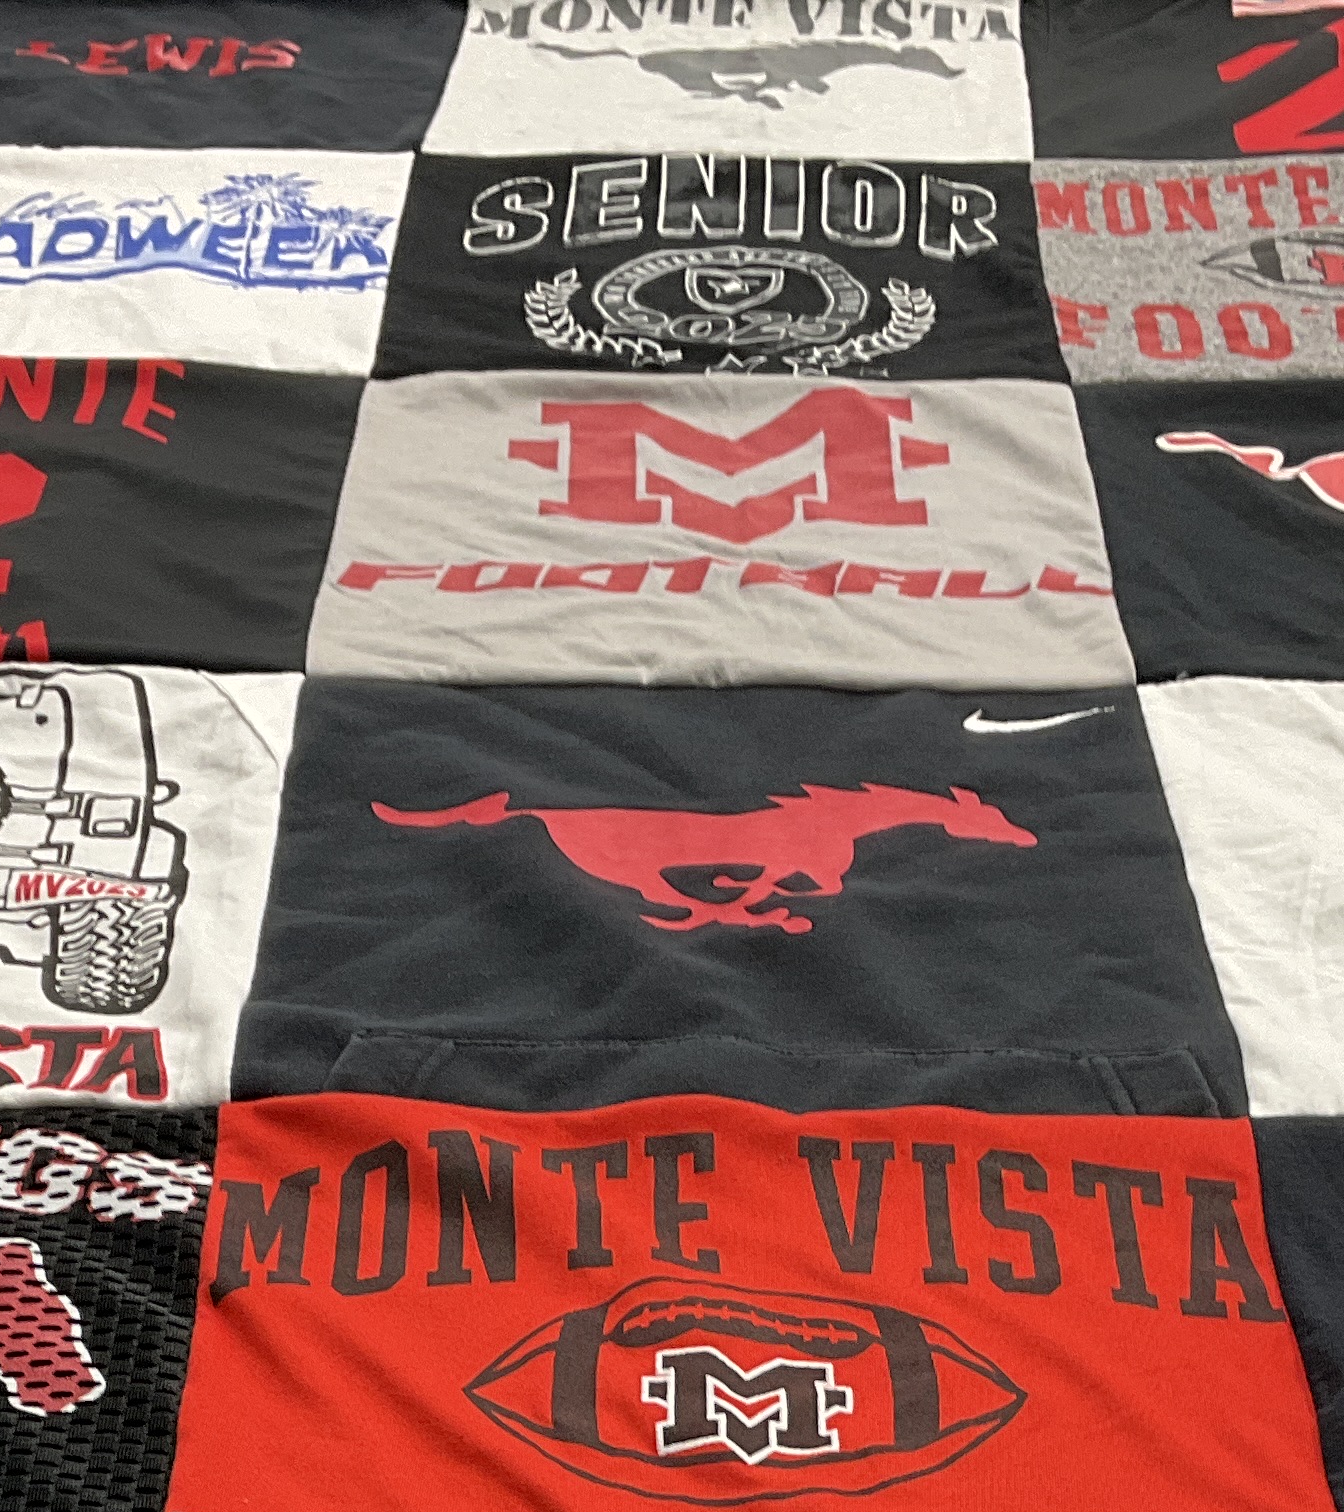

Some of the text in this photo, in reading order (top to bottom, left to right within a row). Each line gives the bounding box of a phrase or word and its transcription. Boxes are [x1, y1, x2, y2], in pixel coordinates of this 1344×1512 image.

[14, 32, 302, 76] LEWIS
[786, 0, 1018, 41] VISTA
[462, 151, 999, 260] SENIOR
[1032, 163, 1340, 236] MONTE
[208, 1127, 1287, 1324] MONTE VISTA
